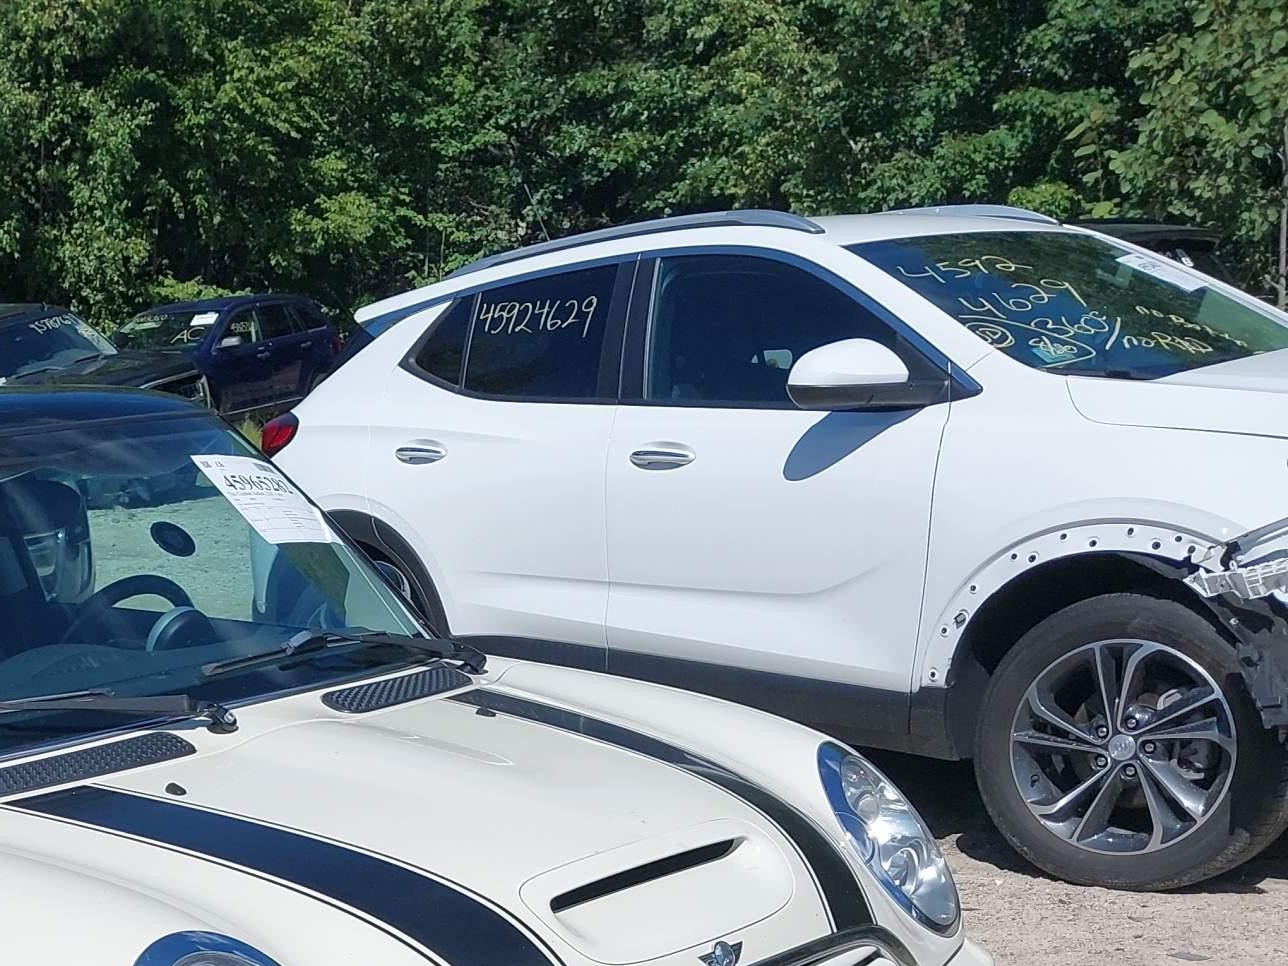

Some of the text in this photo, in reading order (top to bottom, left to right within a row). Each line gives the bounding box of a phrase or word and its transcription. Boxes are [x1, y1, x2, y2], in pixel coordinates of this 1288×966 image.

[897, 255, 1032, 284] 4592
[958, 279, 1087, 319] 4629
[480, 295, 597, 338] 45924629
[170, 326, 205, 344] AC
[223, 474, 294, 495] 45965282
